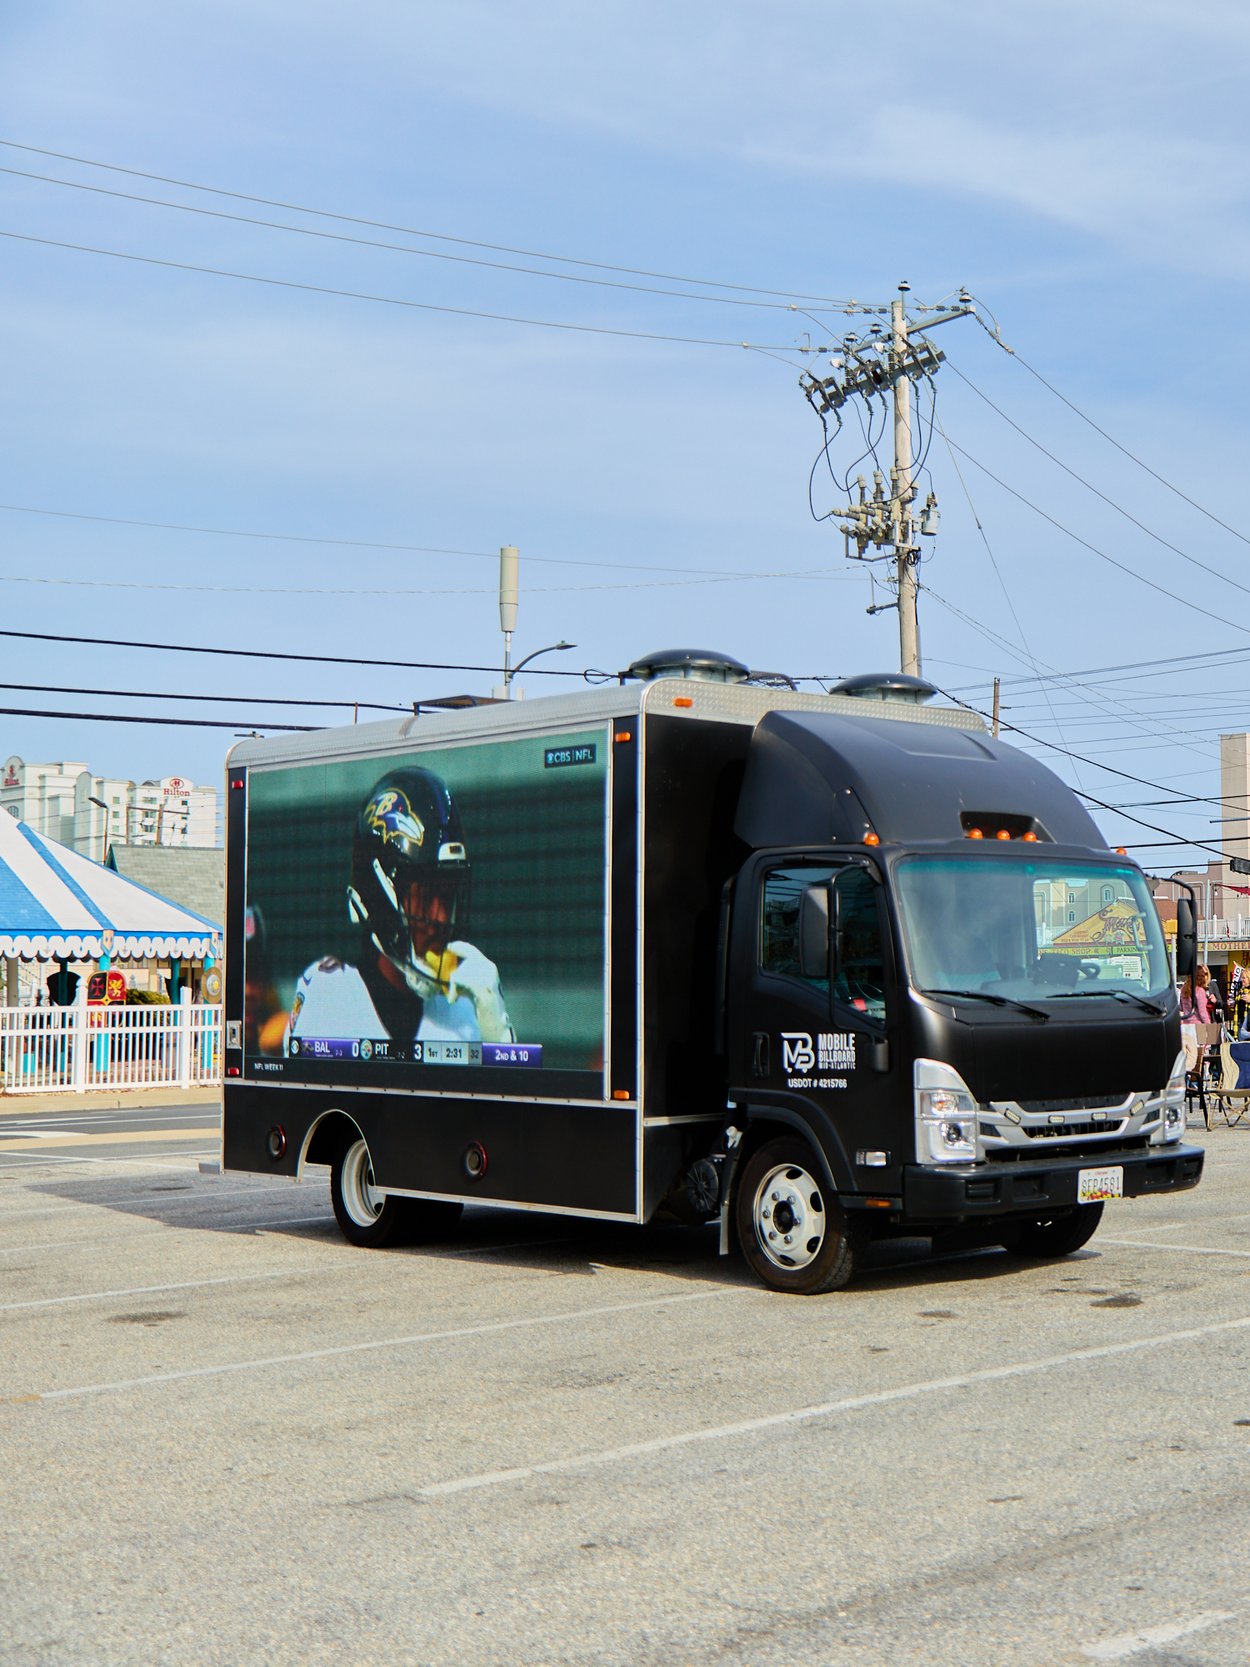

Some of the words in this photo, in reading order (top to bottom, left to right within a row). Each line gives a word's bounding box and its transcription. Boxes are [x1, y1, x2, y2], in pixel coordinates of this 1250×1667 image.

[554, 751, 571, 763] CBS
[575, 748, 593, 761] NFL
[163, 787, 191, 797] Hilton
[817, 1033, 856, 1051] MOBILE
[314, 1041, 331, 1054] BAL
[351, 1042, 359, 1058] 0
[375, 1043, 390, 1055] PIT
[414, 1043, 422, 1060] 3
[446, 1047, 462, 1059] 2:31
[495, 1049, 509, 1061] 2ND
[518, 1050, 529, 1062] 10
[817, 1050, 856, 1062] BILLBOARD
[818, 1062, 856, 1070] MID-ATLANTIC
[788, 1078, 812, 1088] USDOT
